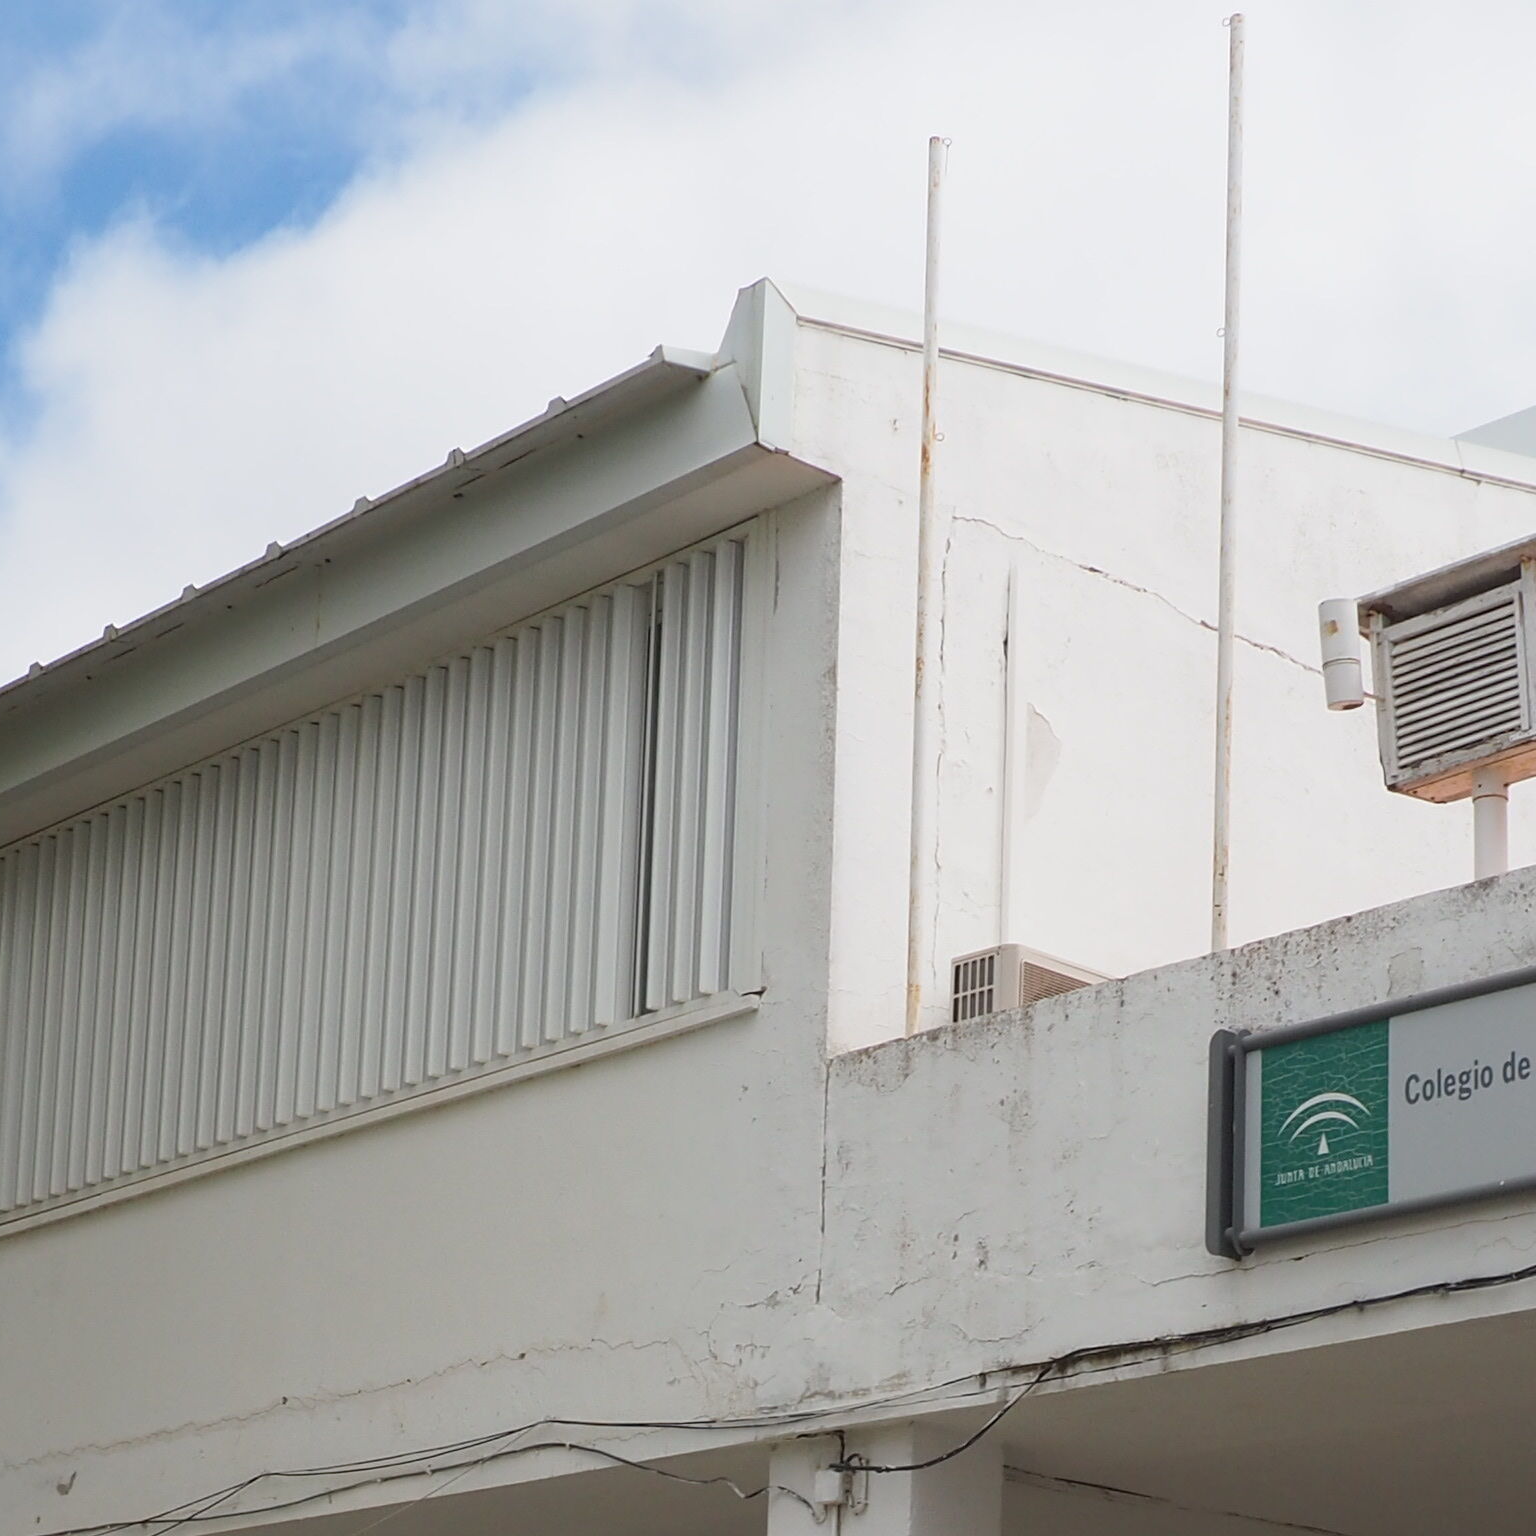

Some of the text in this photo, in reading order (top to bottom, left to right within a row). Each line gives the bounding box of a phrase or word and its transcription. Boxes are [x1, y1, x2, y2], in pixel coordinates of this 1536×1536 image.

[1404, 1060, 1493, 1105] Colegio
[1502, 1051, 1531, 1084] de
[1274, 1168, 1305, 1186] JUNTA
[1308, 1165, 1320, 1179] DE
